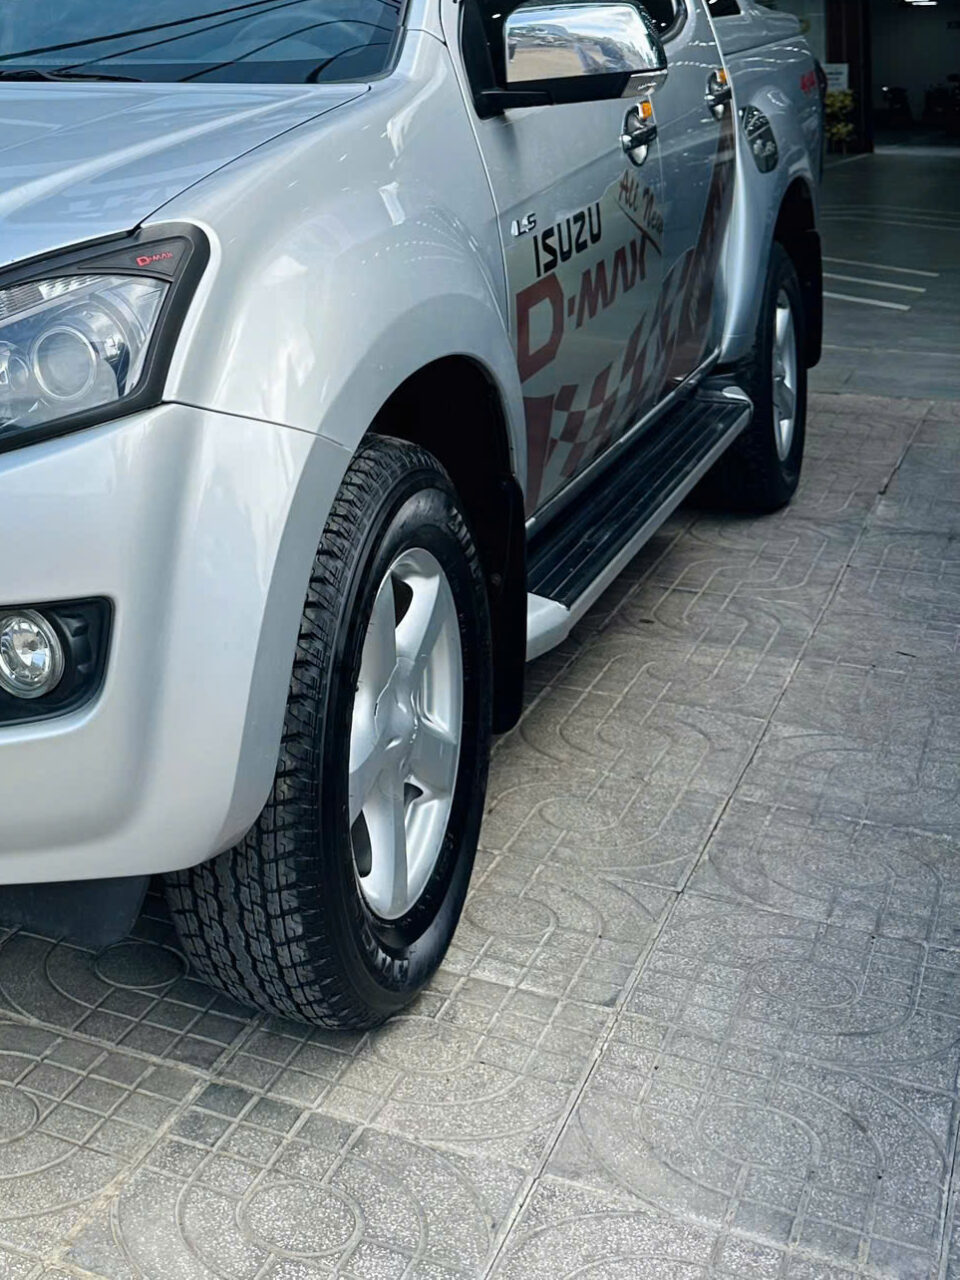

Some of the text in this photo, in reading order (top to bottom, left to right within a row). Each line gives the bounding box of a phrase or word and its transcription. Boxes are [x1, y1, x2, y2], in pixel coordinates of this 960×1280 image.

[511, 212, 537, 237] LS
[533, 202, 602, 278] ISUZU
[515, 233, 662, 384] D-MAX
